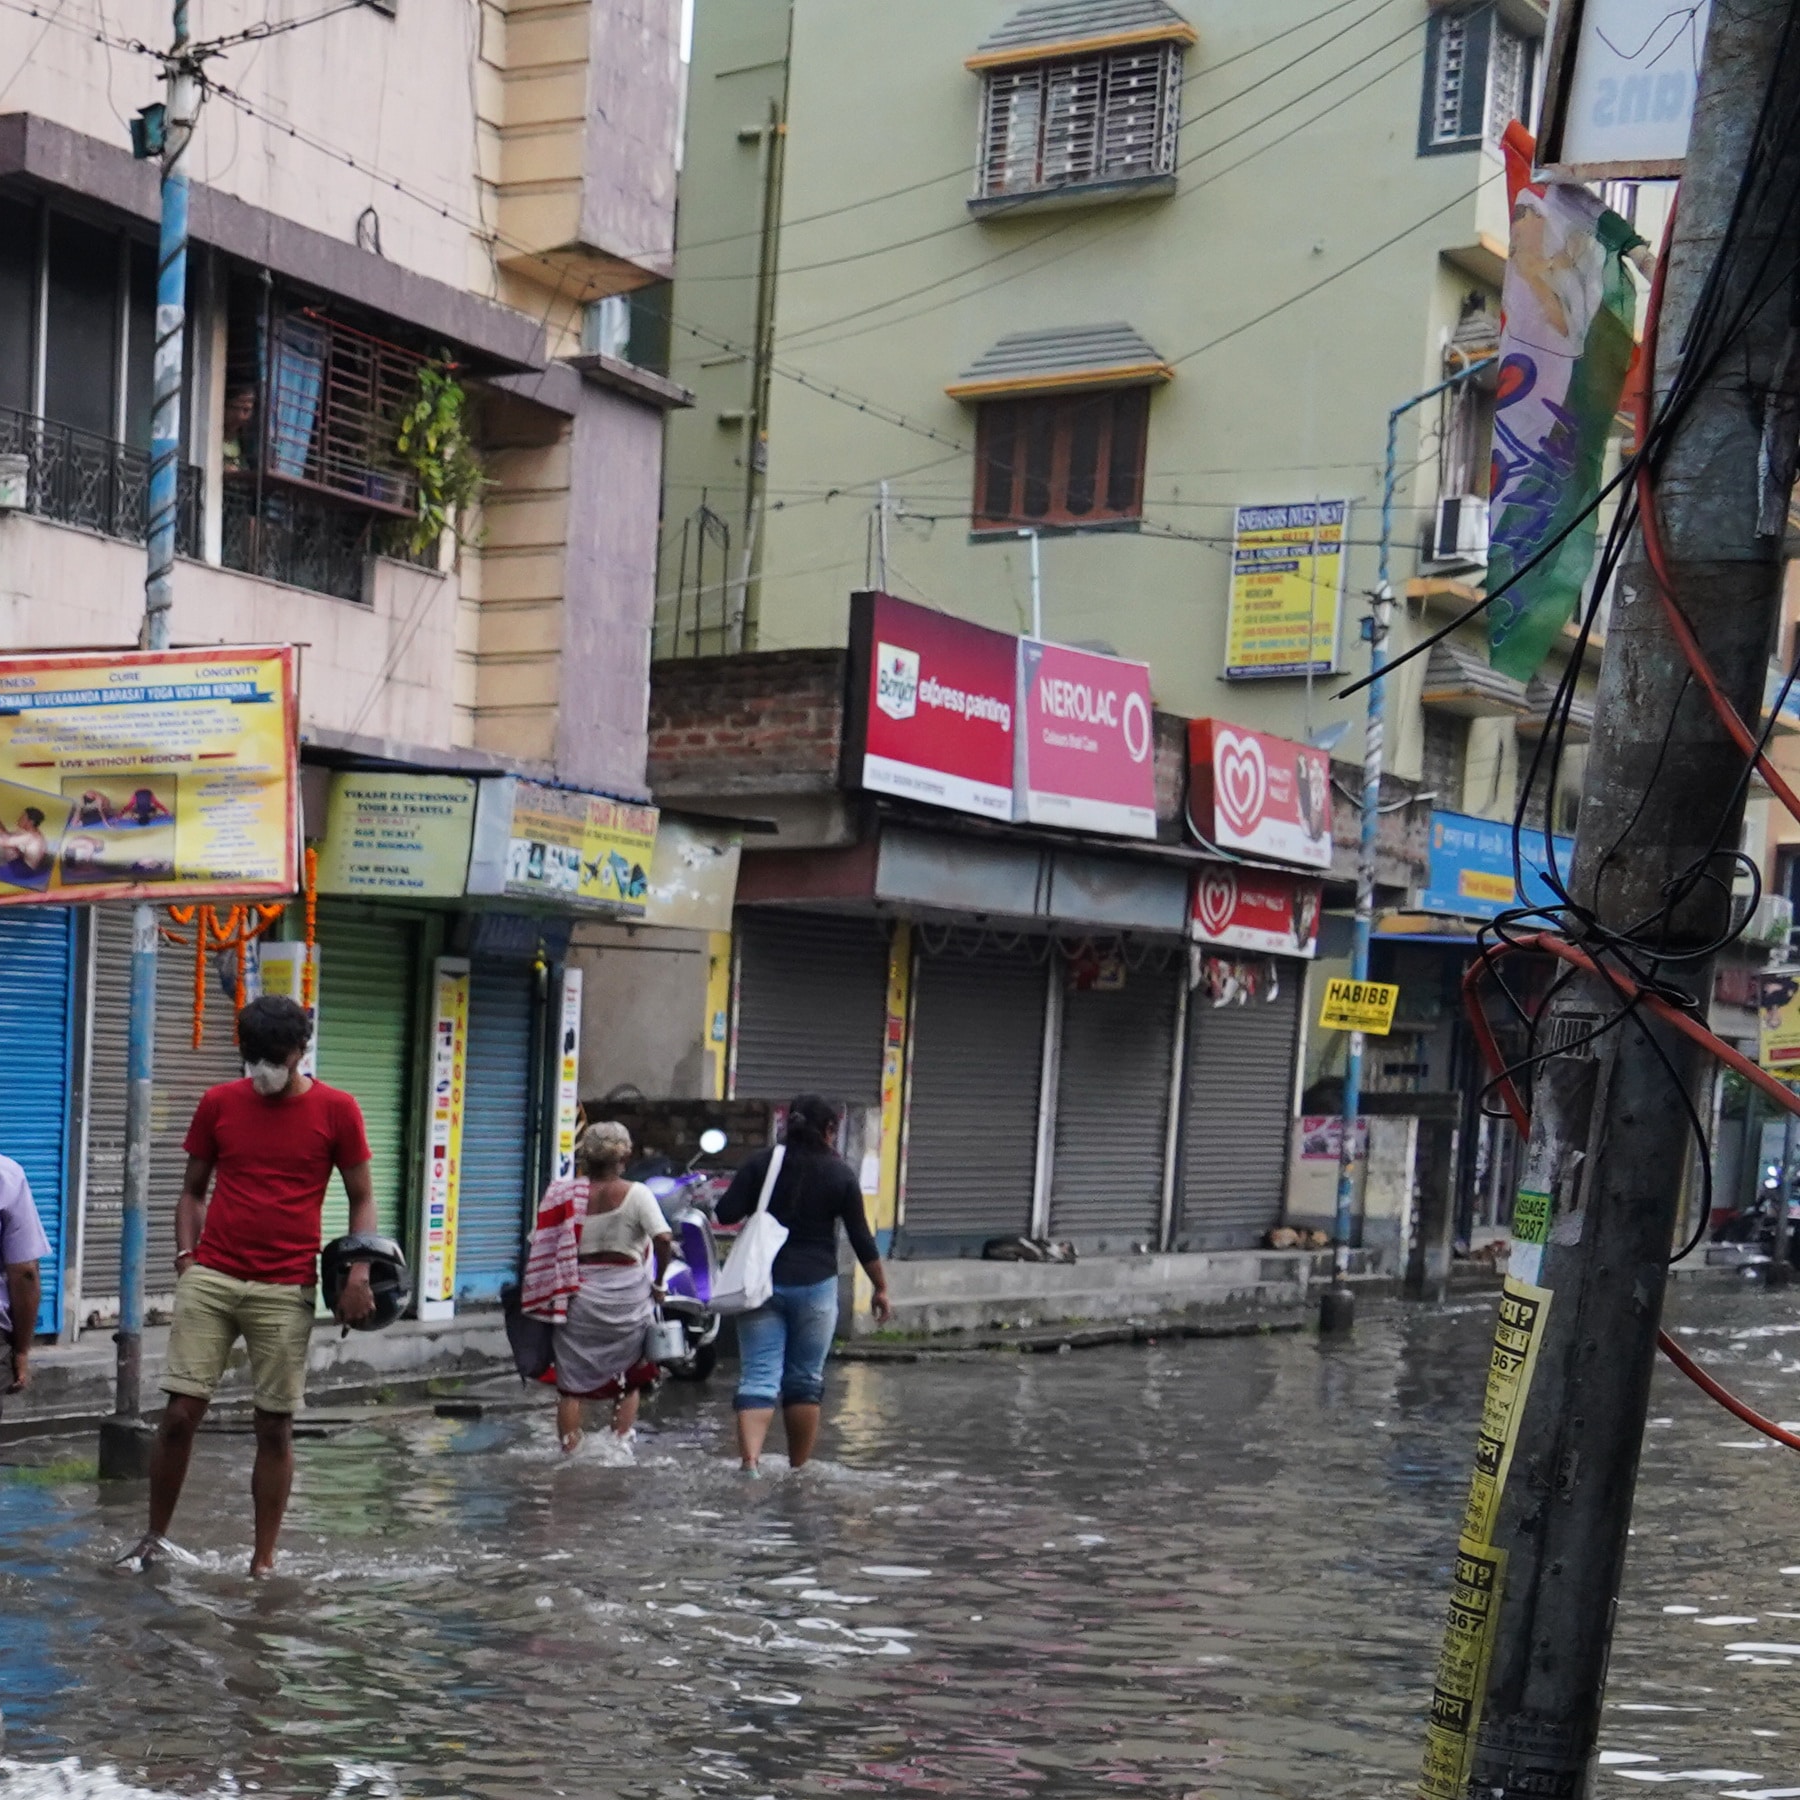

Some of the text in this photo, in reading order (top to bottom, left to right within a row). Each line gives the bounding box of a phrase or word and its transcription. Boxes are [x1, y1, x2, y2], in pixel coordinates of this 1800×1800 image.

[109, 671, 141, 683] CURE
[194, 665, 260, 679] LONGEVITY
[1040, 677, 1118, 728] NEROLAC
[965, 693, 1011, 732] painting
[87, 756, 139, 768] WITHOUT
